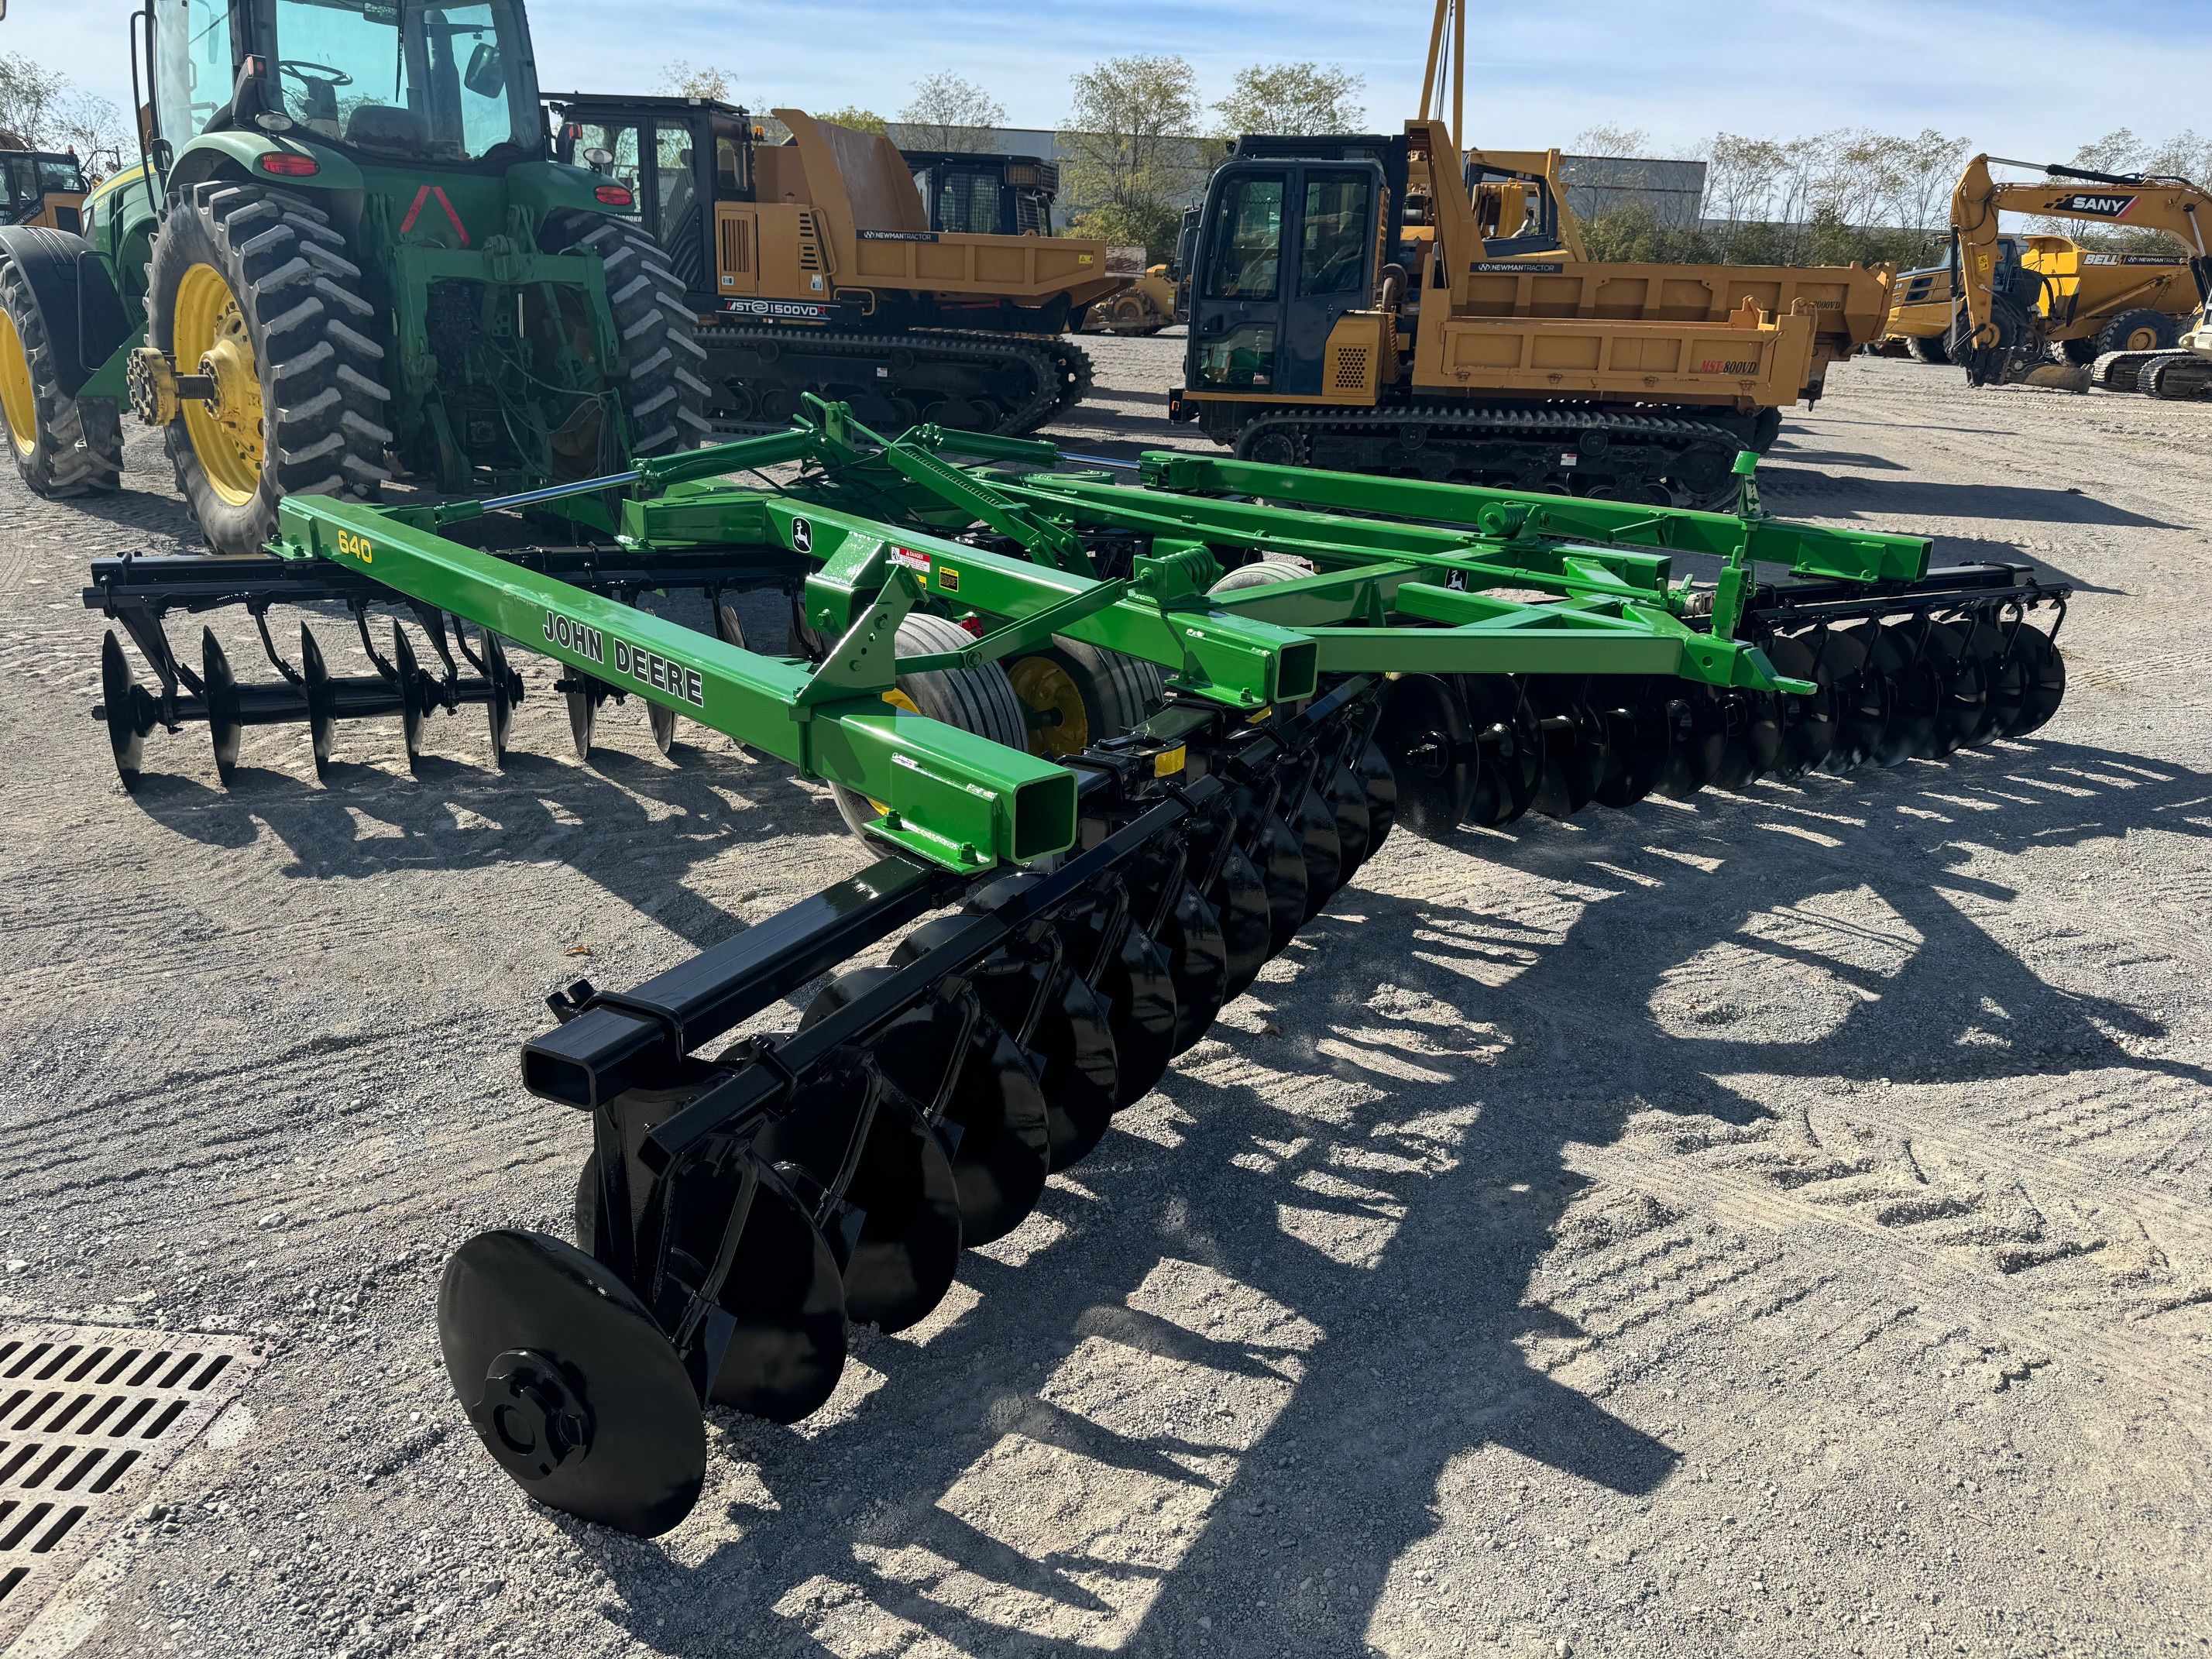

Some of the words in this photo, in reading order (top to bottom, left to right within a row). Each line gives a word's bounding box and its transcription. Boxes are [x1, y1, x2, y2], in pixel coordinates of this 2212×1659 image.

[2073, 197, 2125, 212] SANY
[876, 232, 931, 241] NEWMANTRACTOR
[2083, 254, 2119, 266] BELL
[726, 301, 751, 311] MST
[338, 530, 373, 564] 640
[909, 551, 924, 560] DANGER
[542, 610, 604, 665] JOHN
[613, 637, 704, 709] DEERE
